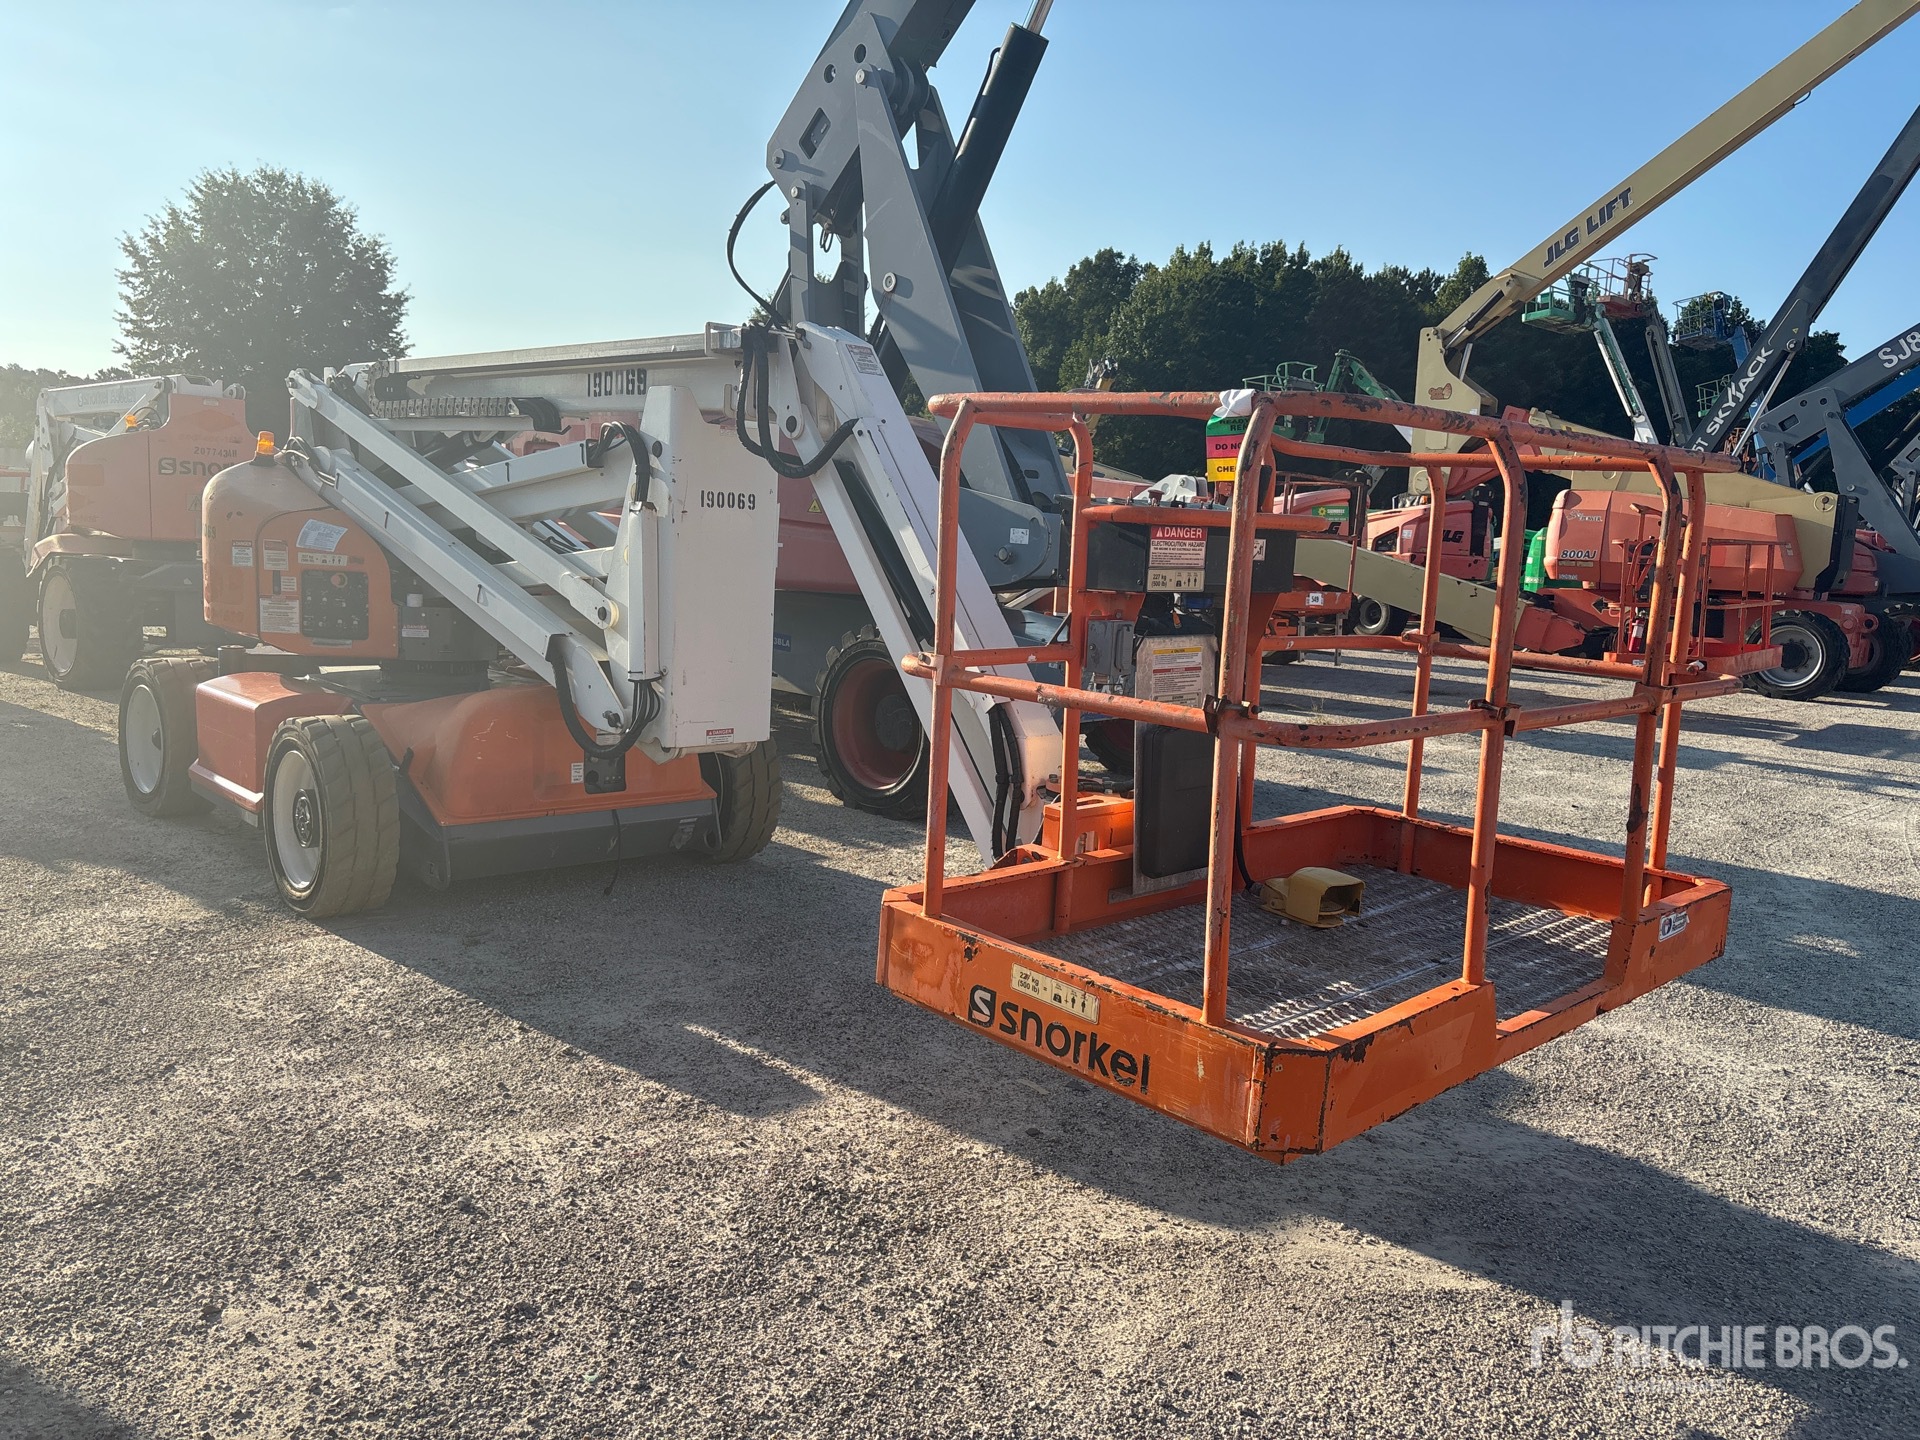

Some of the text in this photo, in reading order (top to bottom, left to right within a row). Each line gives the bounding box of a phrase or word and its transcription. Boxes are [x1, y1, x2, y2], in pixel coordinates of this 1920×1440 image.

[1543, 186, 1632, 268] JLG LIFT
[1706, 346, 1774, 436] SKYJACK
[1217, 465, 1236, 473] CHE
[701, 490, 756, 511] 190069
[1164, 526, 1203, 539] DANGER
[1442, 530, 1464, 543] LG
[1561, 549, 1597, 560] 800AJ
[999, 1000, 1151, 1095] snorkel
